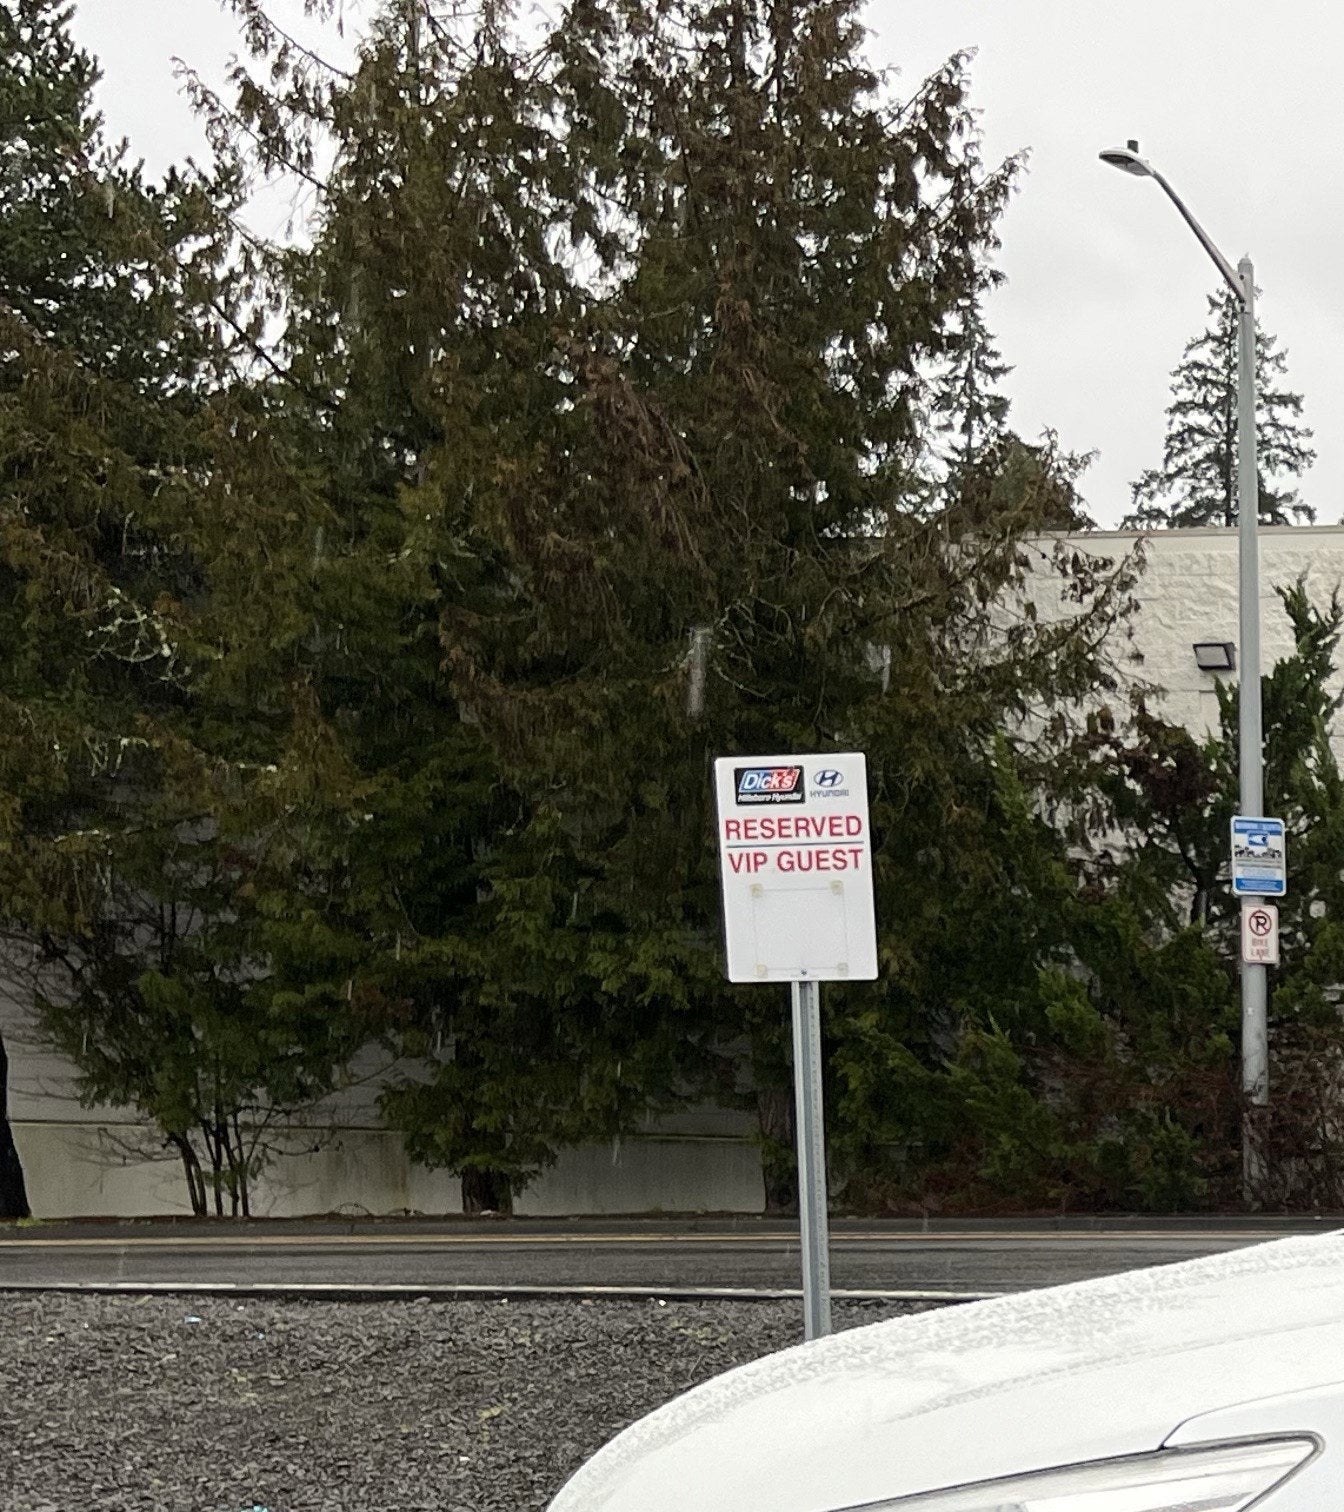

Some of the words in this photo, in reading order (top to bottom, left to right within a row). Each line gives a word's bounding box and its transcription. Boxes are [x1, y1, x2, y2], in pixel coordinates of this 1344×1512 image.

[725, 815, 862, 840] RESERVED
[728, 851, 768, 874] VIP
[777, 848, 863, 872] GUEST
